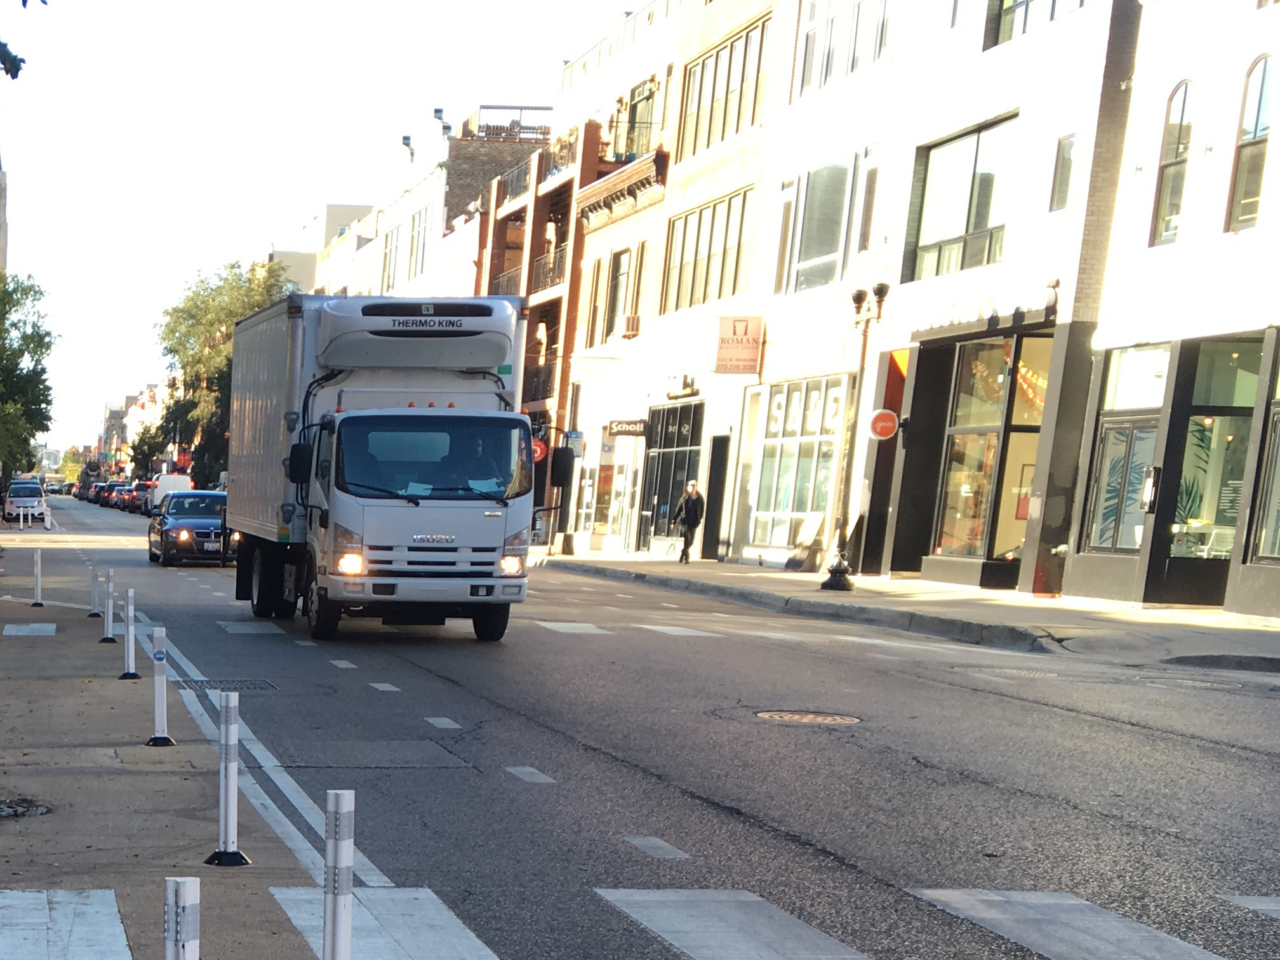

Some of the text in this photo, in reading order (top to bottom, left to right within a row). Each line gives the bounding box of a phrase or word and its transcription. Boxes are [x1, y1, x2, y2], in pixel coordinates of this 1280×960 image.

[391, 319, 463, 328] THERMO KING
[720, 337, 760, 345] ROMAN
[412, 534, 456, 544] ISUZU
